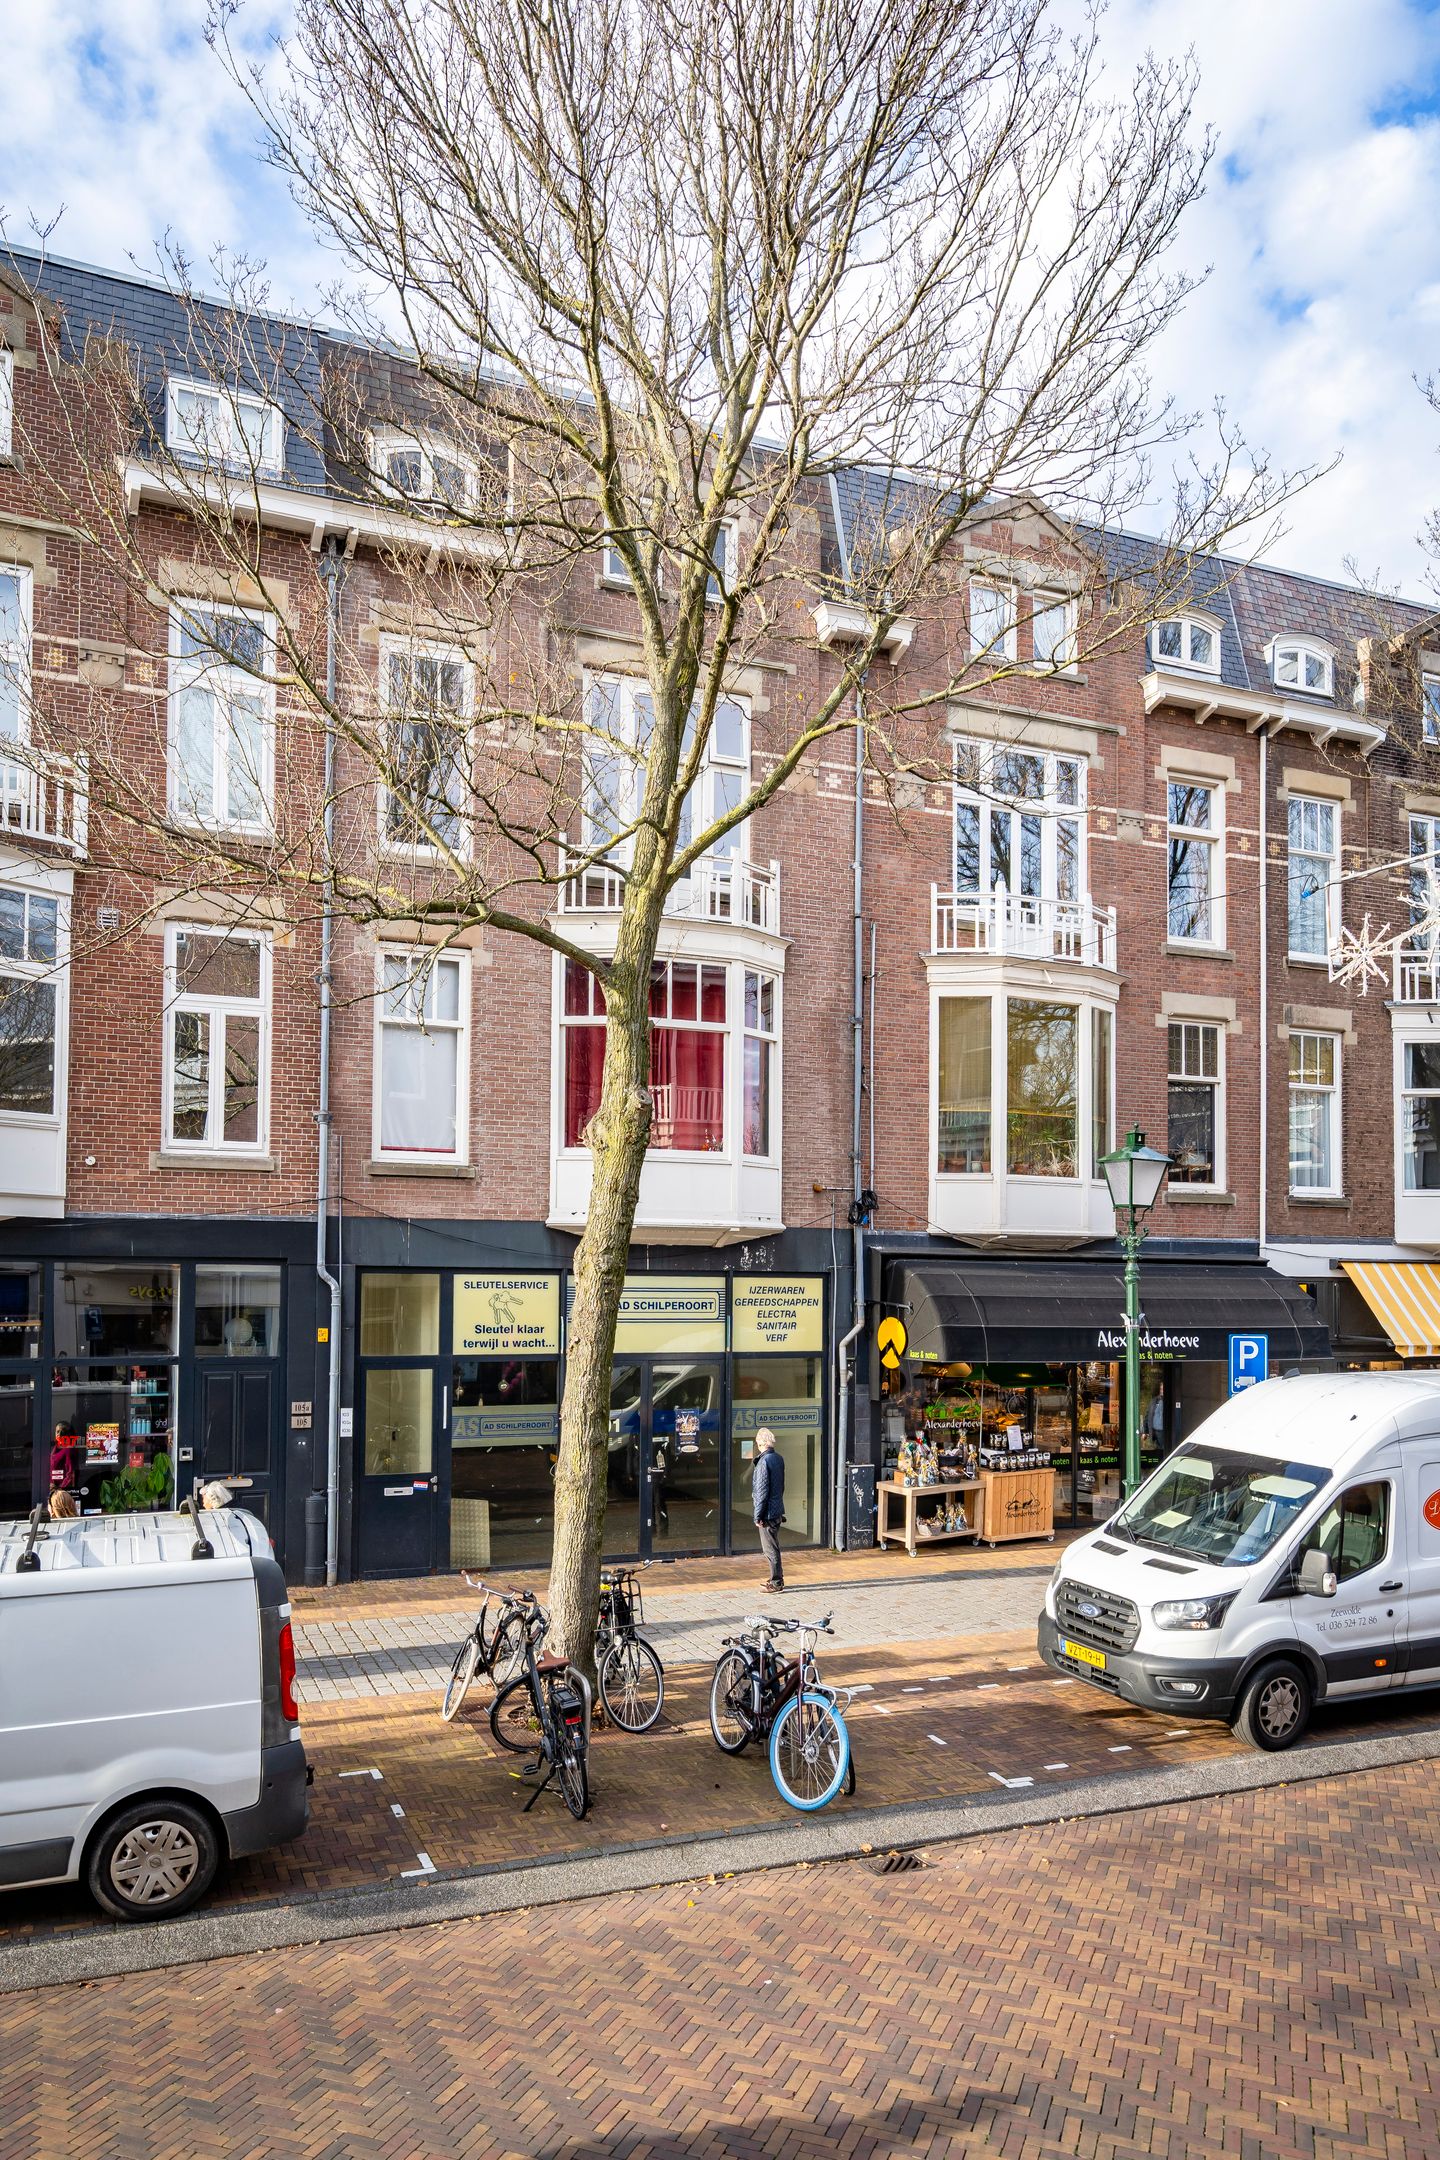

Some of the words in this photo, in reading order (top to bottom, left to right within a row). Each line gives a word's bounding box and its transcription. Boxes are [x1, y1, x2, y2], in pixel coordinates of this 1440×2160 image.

[463, 1281, 549, 1290] SLEUTELSERVICE
[749, 1286, 806, 1295] IJZERWAREN
[633, 1301, 714, 1310] SCHILPEROORT
[734, 1298, 820, 1307] GEREEDSCHAPPEN
[757, 1310, 797, 1319] ELECTRA
[474, 1324, 514, 1334] Sleutel
[517, 1324, 545, 1334] klaar
[756, 1322, 798, 1331] SANITAIR
[765, 1333, 788, 1342] VERF
[463, 1339, 499, 1350] terwijl
[502, 1340, 509, 1348] u
[512, 1339, 555, 1348] wacht...
[1147, 1351, 1153, 1360] &
[1154, 1351, 1174, 1360] noten
[1239, 1340, 1259, 1370] P
[295, 1404, 310, 1412] 105a
[769, 1414, 816, 1422] SCHILPEROORT
[496, 1421, 551, 1430] SCHILPEROORT
[1079, 1456, 1093, 1464] kaas
[1101, 1455, 1118, 1463] noten
[1330, 1605, 1362, 1618] Zeewolde
[1329, 1622, 1343, 1630] 036
[1344, 1619, 1357, 1628] 524
[1358, 1617, 1367, 1626] 72
[1368, 1616, 1378, 1624] 86
